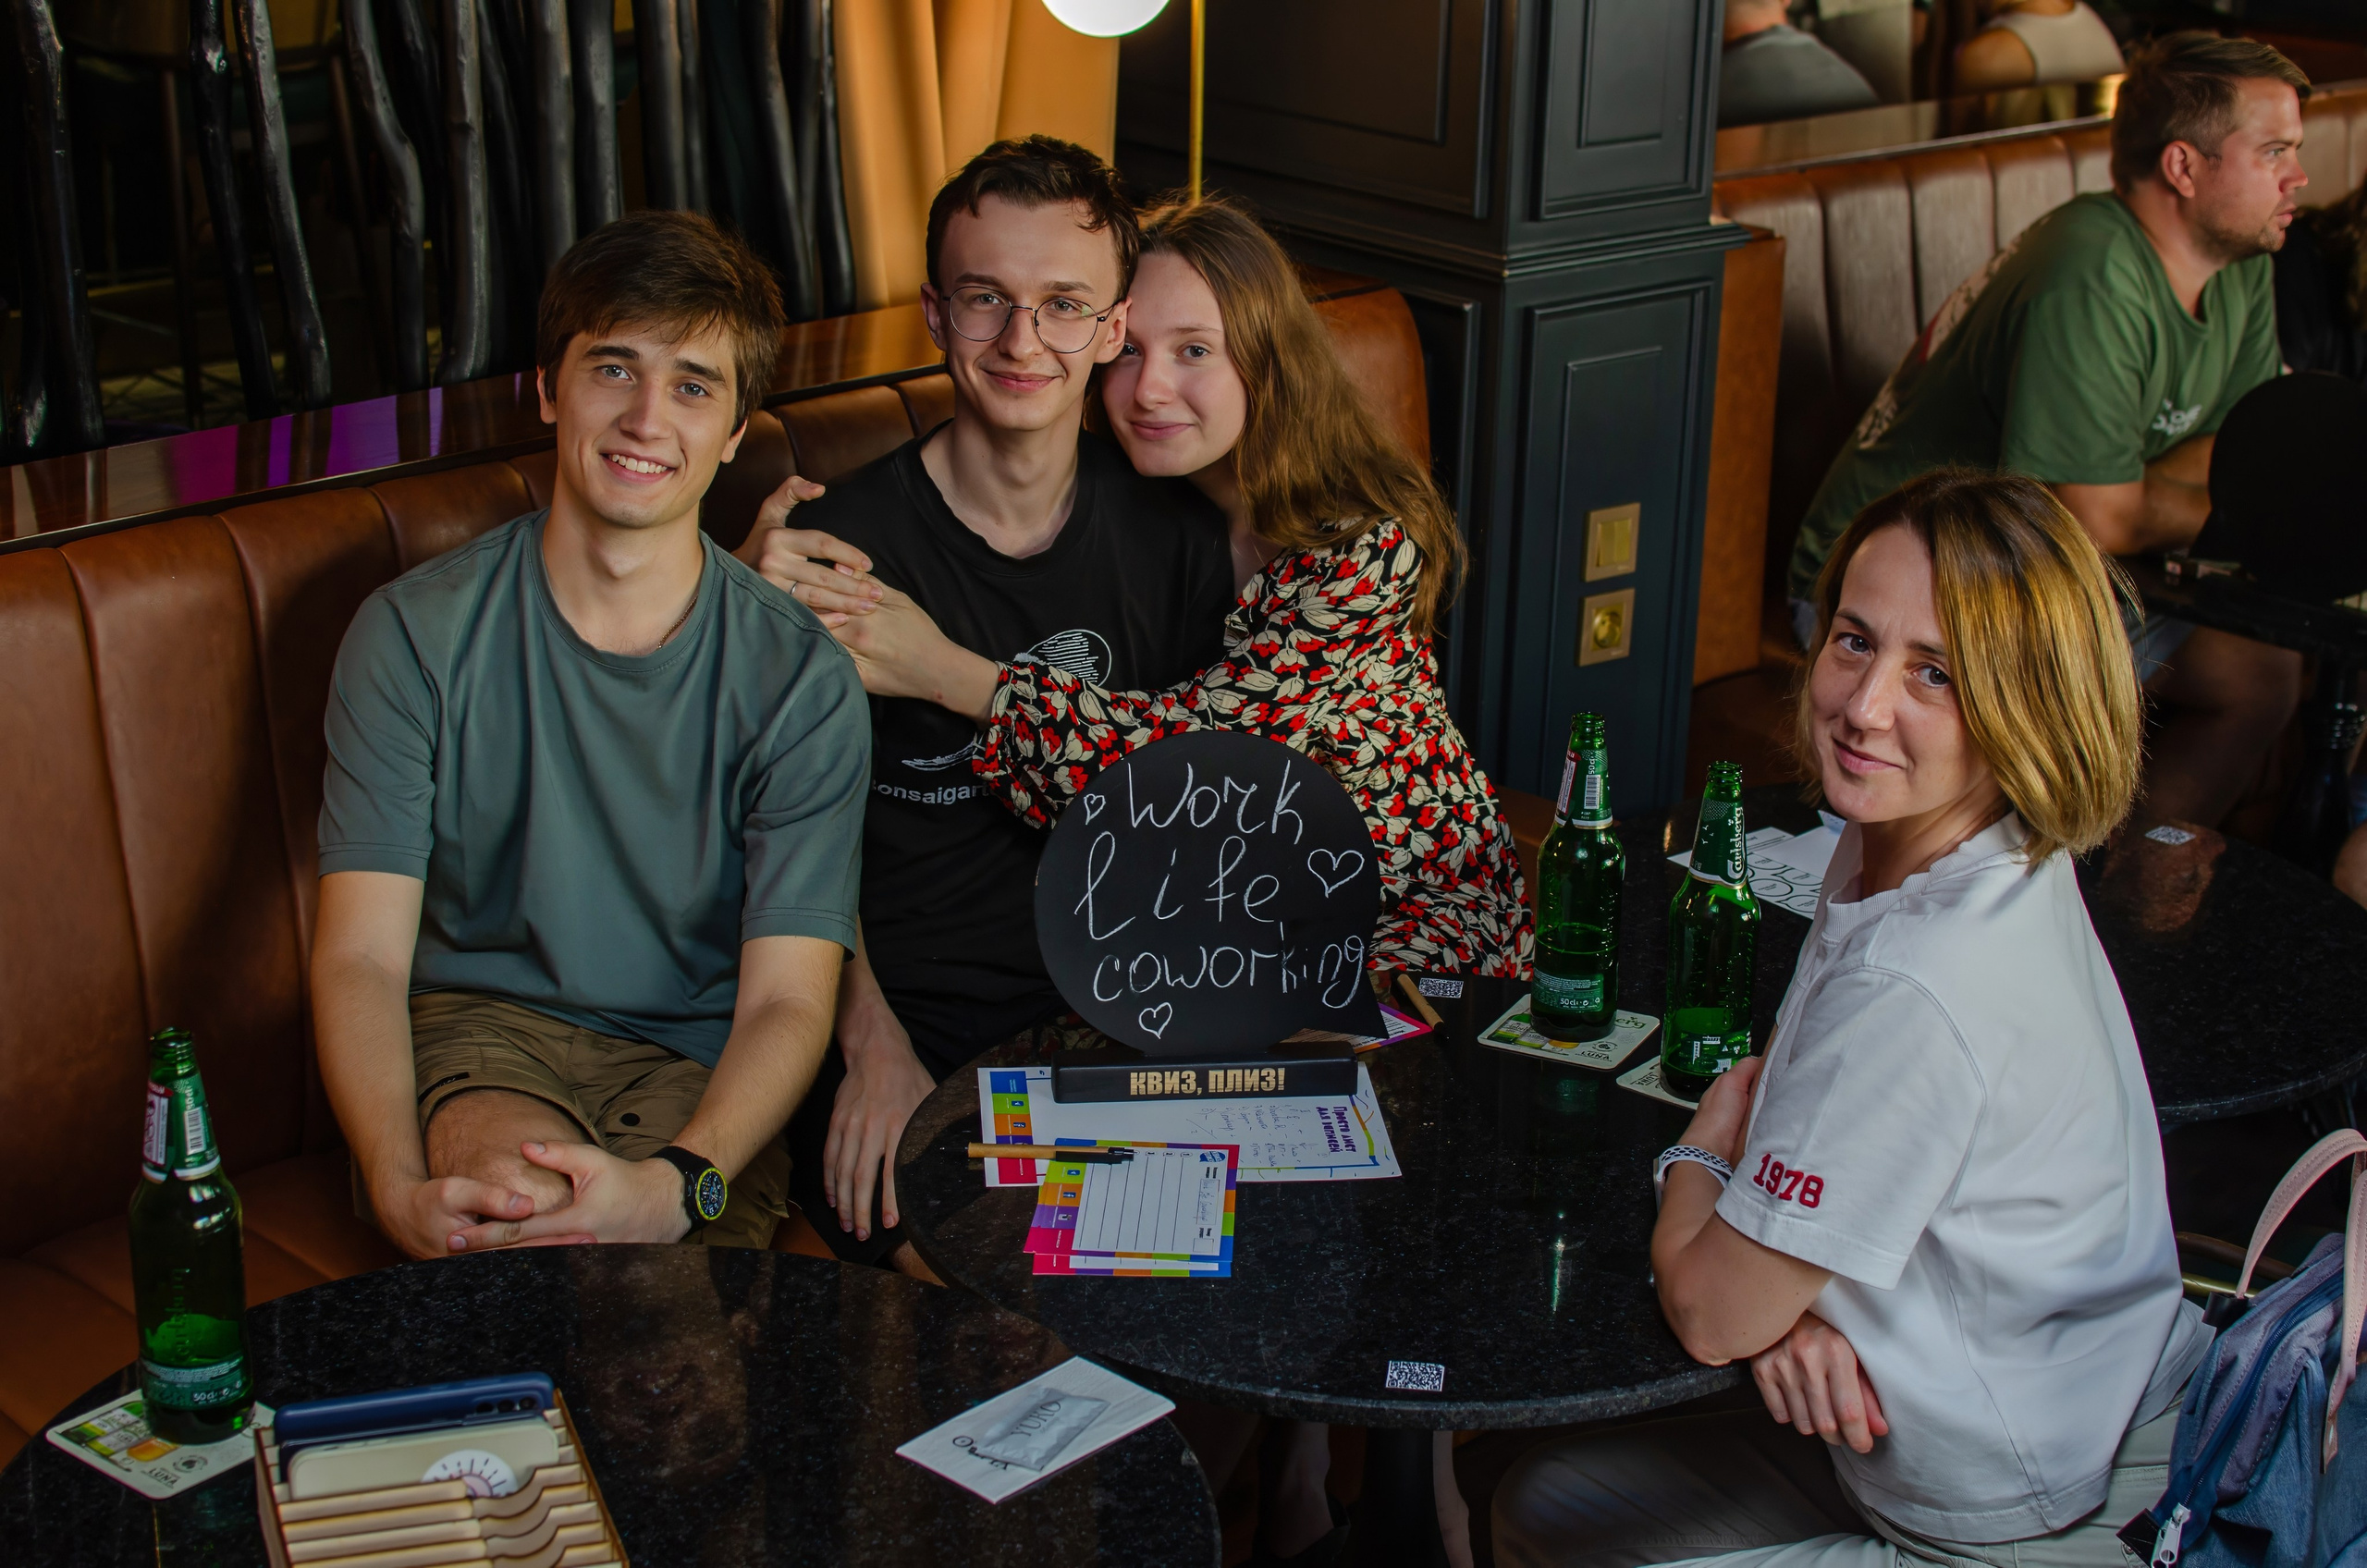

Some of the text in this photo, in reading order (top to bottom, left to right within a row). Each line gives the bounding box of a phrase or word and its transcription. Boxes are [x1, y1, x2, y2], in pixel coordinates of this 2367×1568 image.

[1126, 757, 1304, 844] Work
[1726, 806, 1747, 879] Carlsberg
[1580, 1050, 1611, 1062] LUNA
[1129, 1067, 1285, 1096] КВИЗ, ПЛИЗ!
[1753, 1153, 1824, 1208] 1978
[1011, 1401, 1061, 1437] YUKO
[149, 1466, 178, 1486] LUNA
